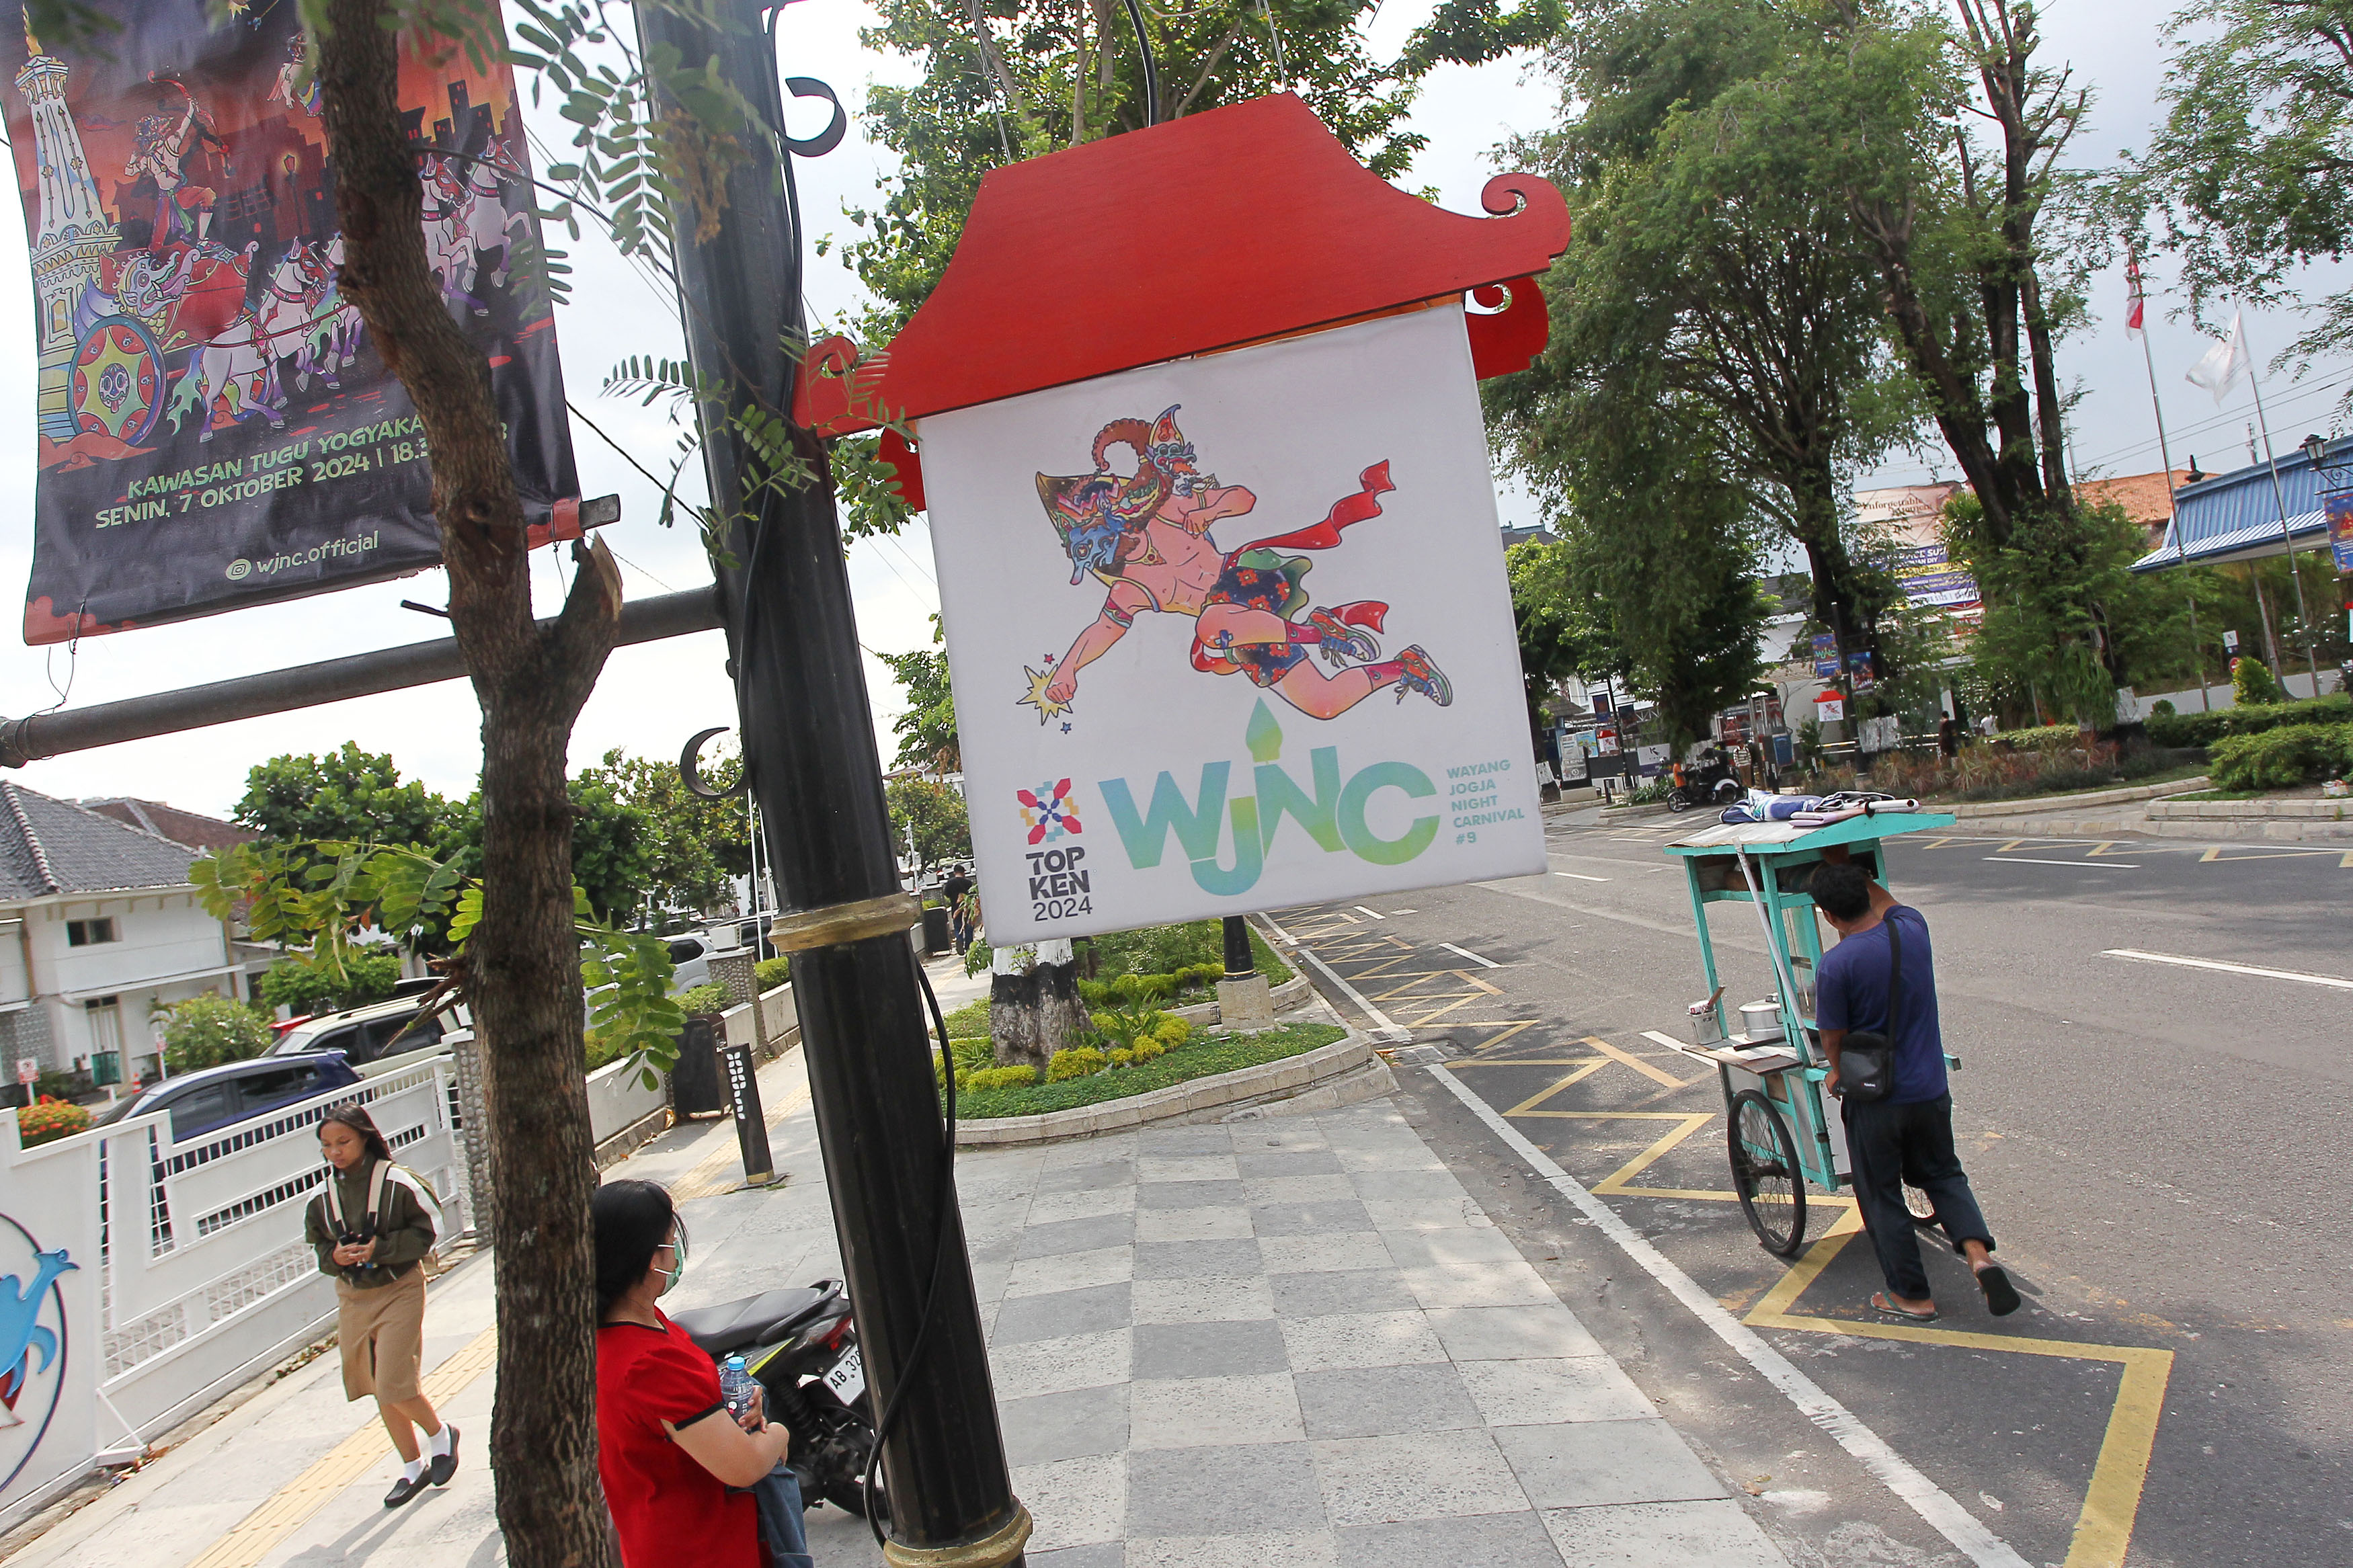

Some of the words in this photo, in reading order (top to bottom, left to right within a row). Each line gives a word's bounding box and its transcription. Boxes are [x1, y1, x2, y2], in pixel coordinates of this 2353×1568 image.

[127, 458, 243, 499] KAWASAN
[249, 441, 309, 472] TUGU
[317, 414, 426, 454] YOGYAKA
[95, 499, 171, 529] SENIN,
[180, 493, 193, 513] 7
[200, 466, 303, 508] OKTOBER
[311, 452, 370, 483] 2024
[390, 437, 428, 464] 18.3
[256, 530, 379, 575] wjnc.official
[1447, 759, 1511, 780] WAYANG
[1449, 778, 1497, 796] JOGJA
[1451, 795, 1498, 813] NIGHT
[1453, 808, 1525, 829] CARNIVAL
[1025, 846, 1085, 876] TOP
[1029, 870, 1090, 901] KEN
[1033, 895, 1093, 922] 2024
[830, 1370, 847, 1390] AB
